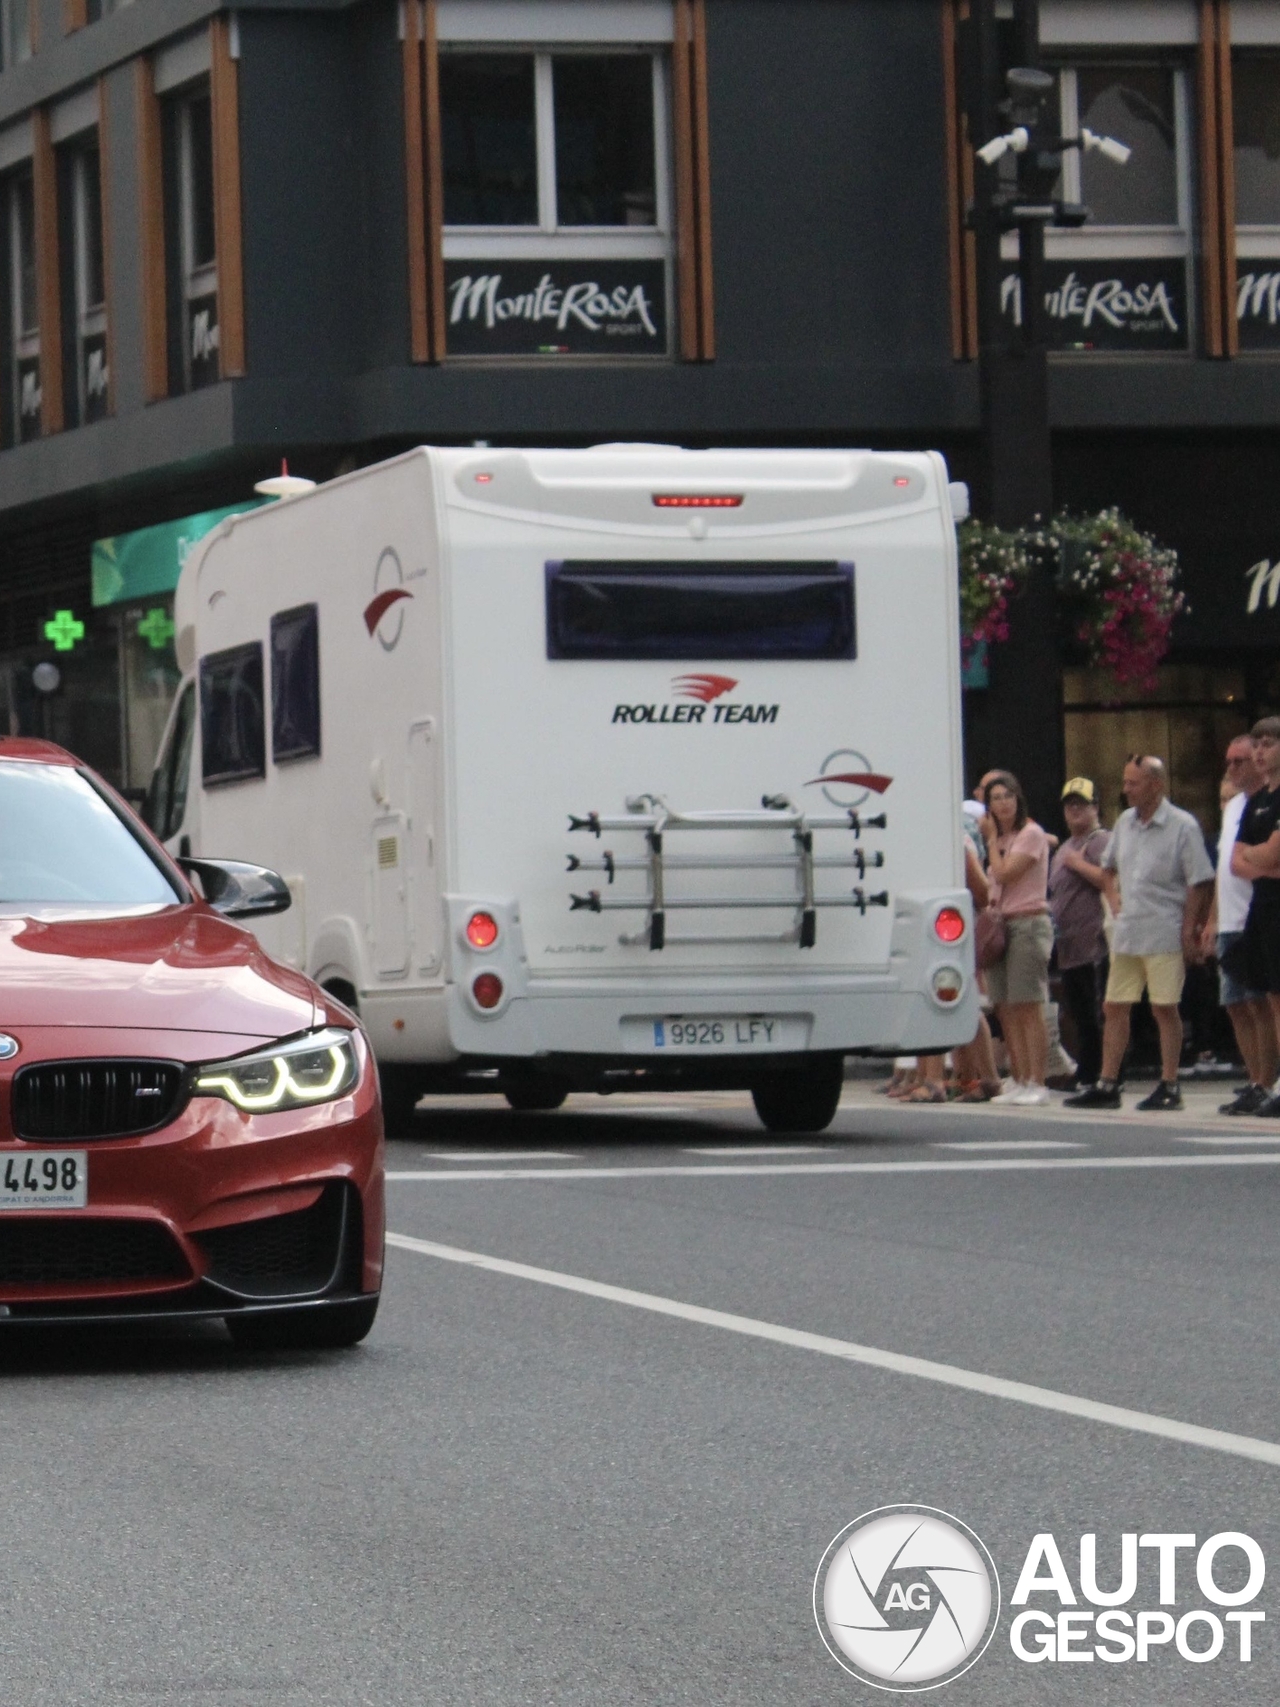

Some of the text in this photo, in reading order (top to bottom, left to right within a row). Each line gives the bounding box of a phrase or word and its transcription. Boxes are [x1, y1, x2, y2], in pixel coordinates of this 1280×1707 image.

[611, 703, 781, 723] ROLLER TEAM
[671, 1021, 774, 1044] 9926 LFY
[4, 1157, 77, 1192] 4498
